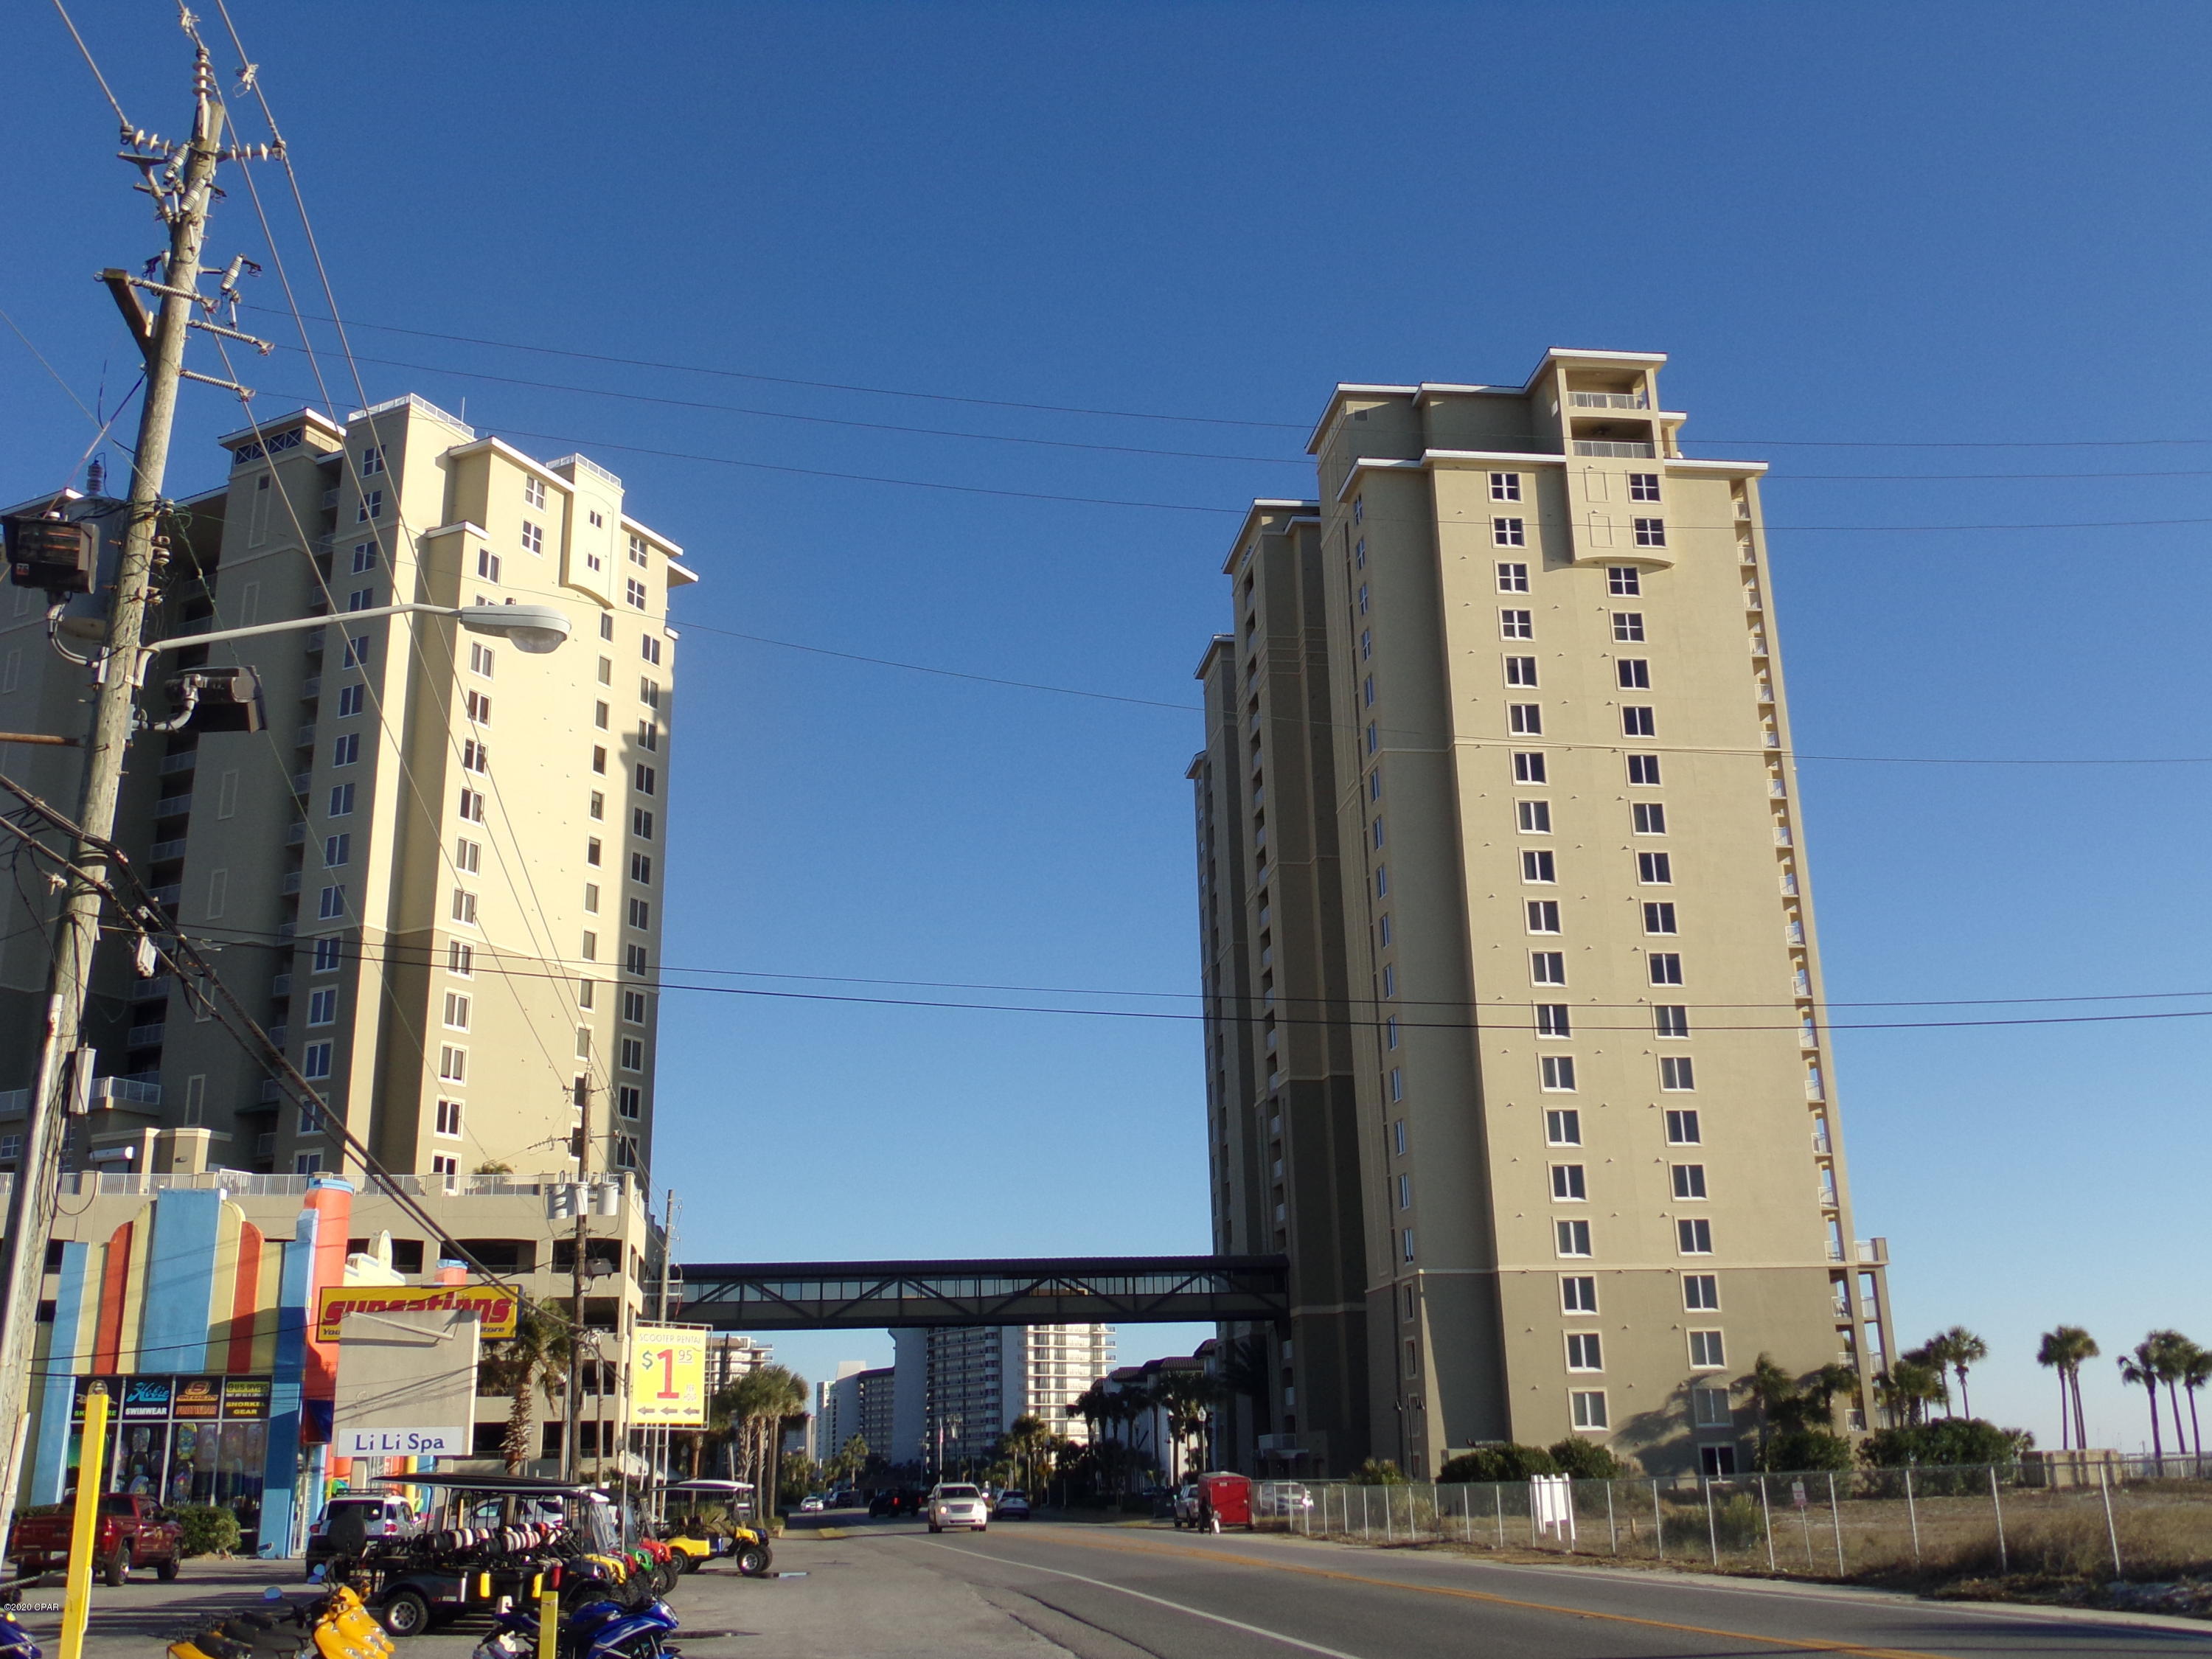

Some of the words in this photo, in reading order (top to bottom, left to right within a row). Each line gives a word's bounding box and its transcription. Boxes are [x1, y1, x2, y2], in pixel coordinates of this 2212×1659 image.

[639, 1333, 674, 1342] SCOOTER
[678, 1350, 692, 1361] 95
[126, 1382, 169, 1402] Hobie
[125, 1407, 167, 1415] SWIMWEAR
[355, 1434, 374, 1450] Li
[382, 1433, 400, 1450] Li
[408, 1433, 445, 1453] Spa
